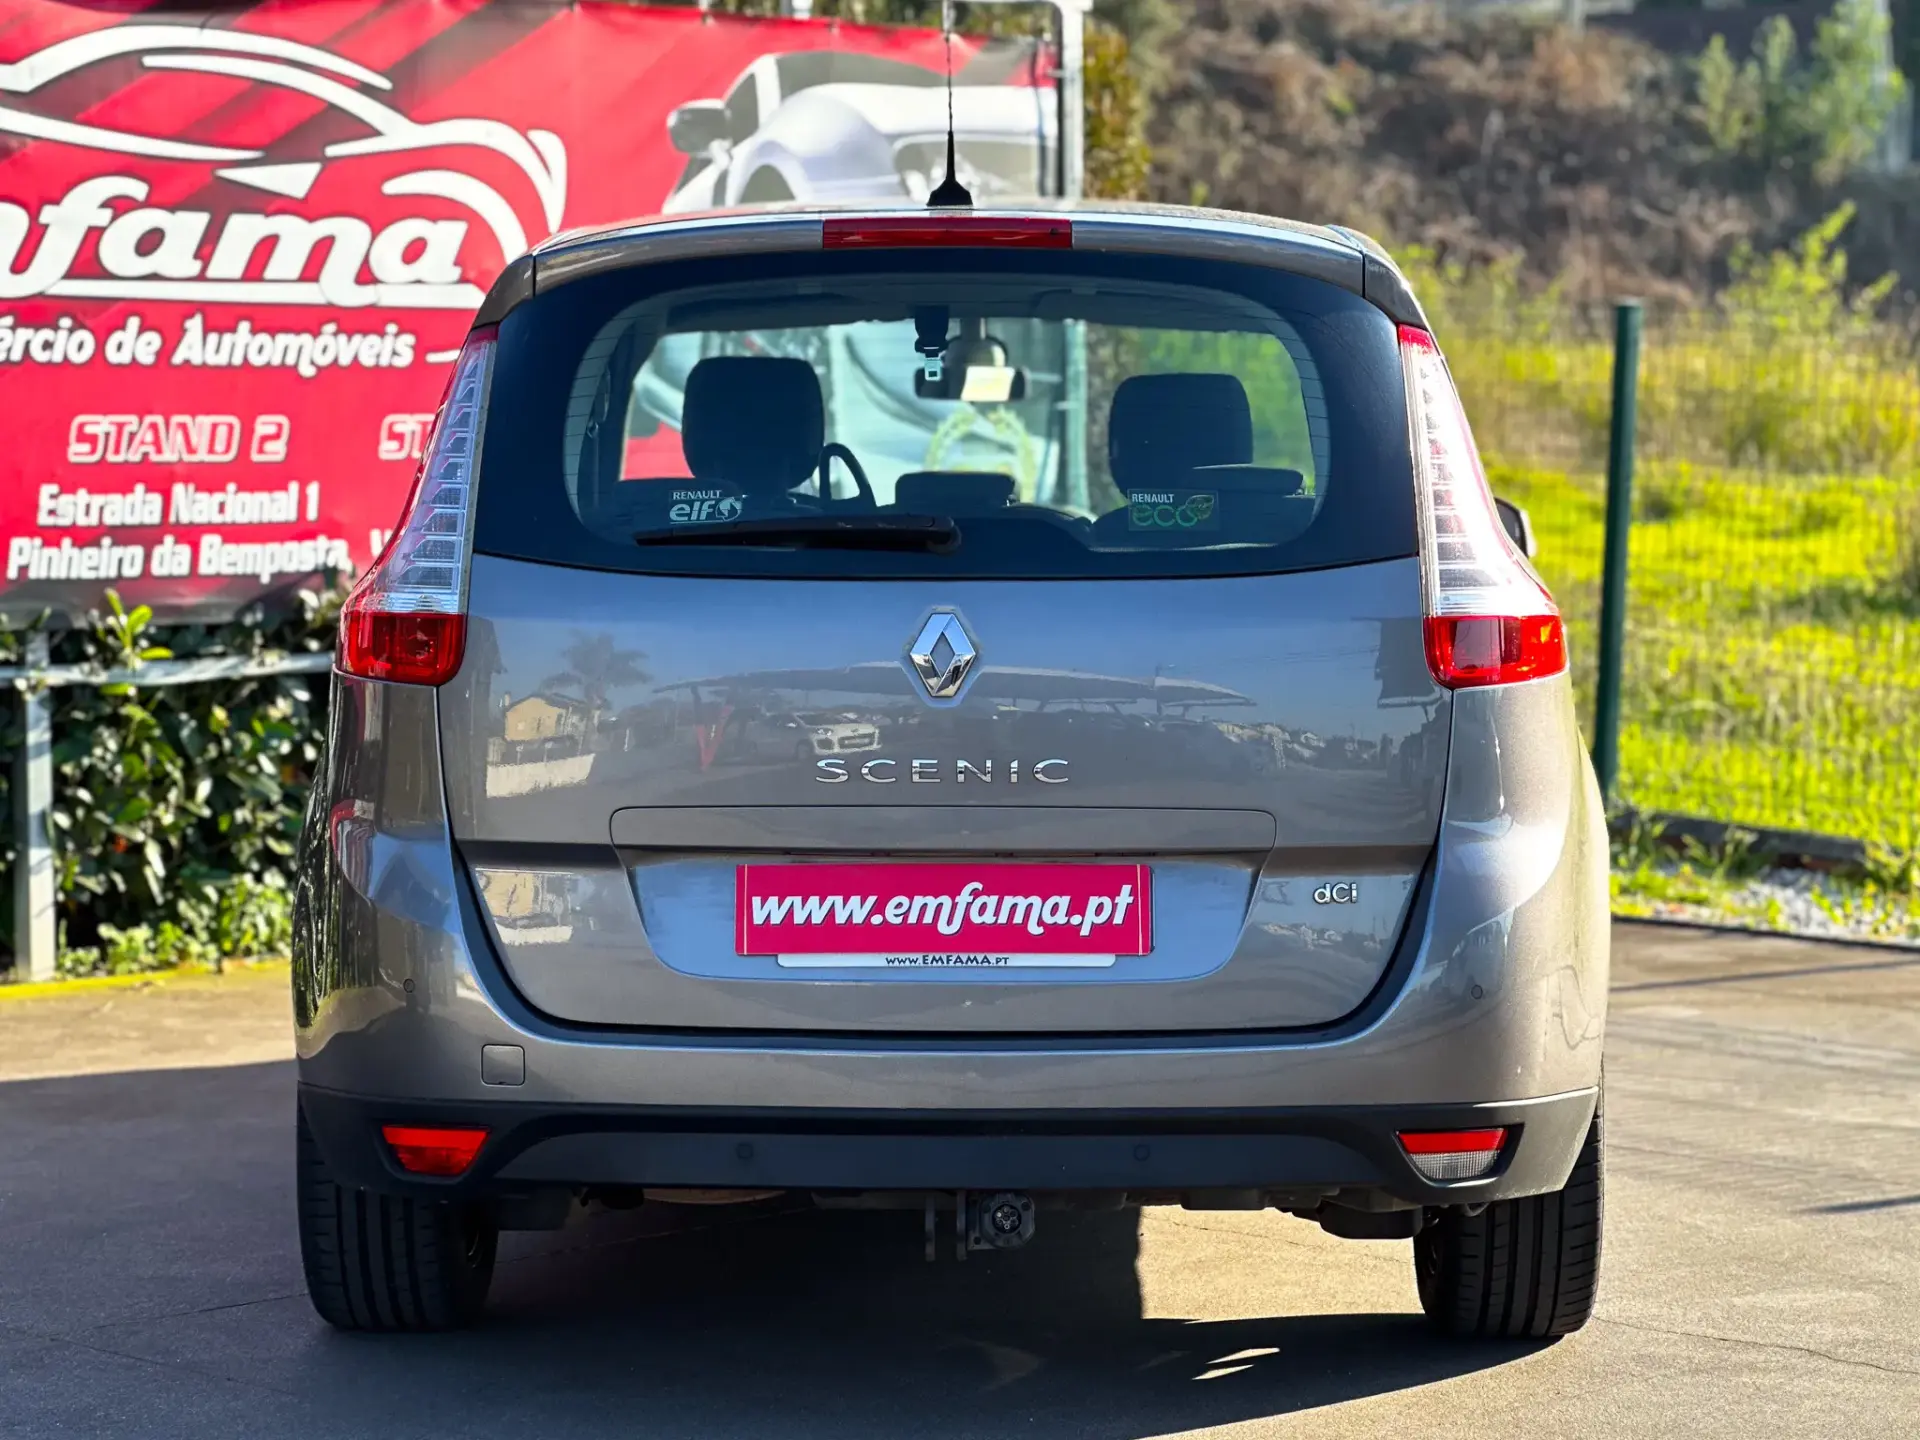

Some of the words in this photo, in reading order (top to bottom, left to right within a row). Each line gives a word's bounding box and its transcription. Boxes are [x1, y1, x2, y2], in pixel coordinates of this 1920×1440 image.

[104, 315, 163, 365] de
[67, 414, 240, 463] STAND
[250, 414, 290, 462] 2
[37, 484, 162, 526] Estrada
[169, 480, 299, 524] Nacional
[305, 480, 320, 521] 1
[673, 490, 722, 500] RENAULT
[1131, 493, 1175, 503] RENAULT
[669, 500, 715, 521] elf
[1132, 504, 1198, 527] eco
[6, 536, 144, 579] Pinheiro
[151, 534, 192, 577] da
[815, 758, 1070, 784] SCENIC
[1313, 882, 1357, 904] dCi
[751, 881, 1134, 937] www.emfama.pt
[885, 954, 1010, 966] www.EMFAMA.PT
